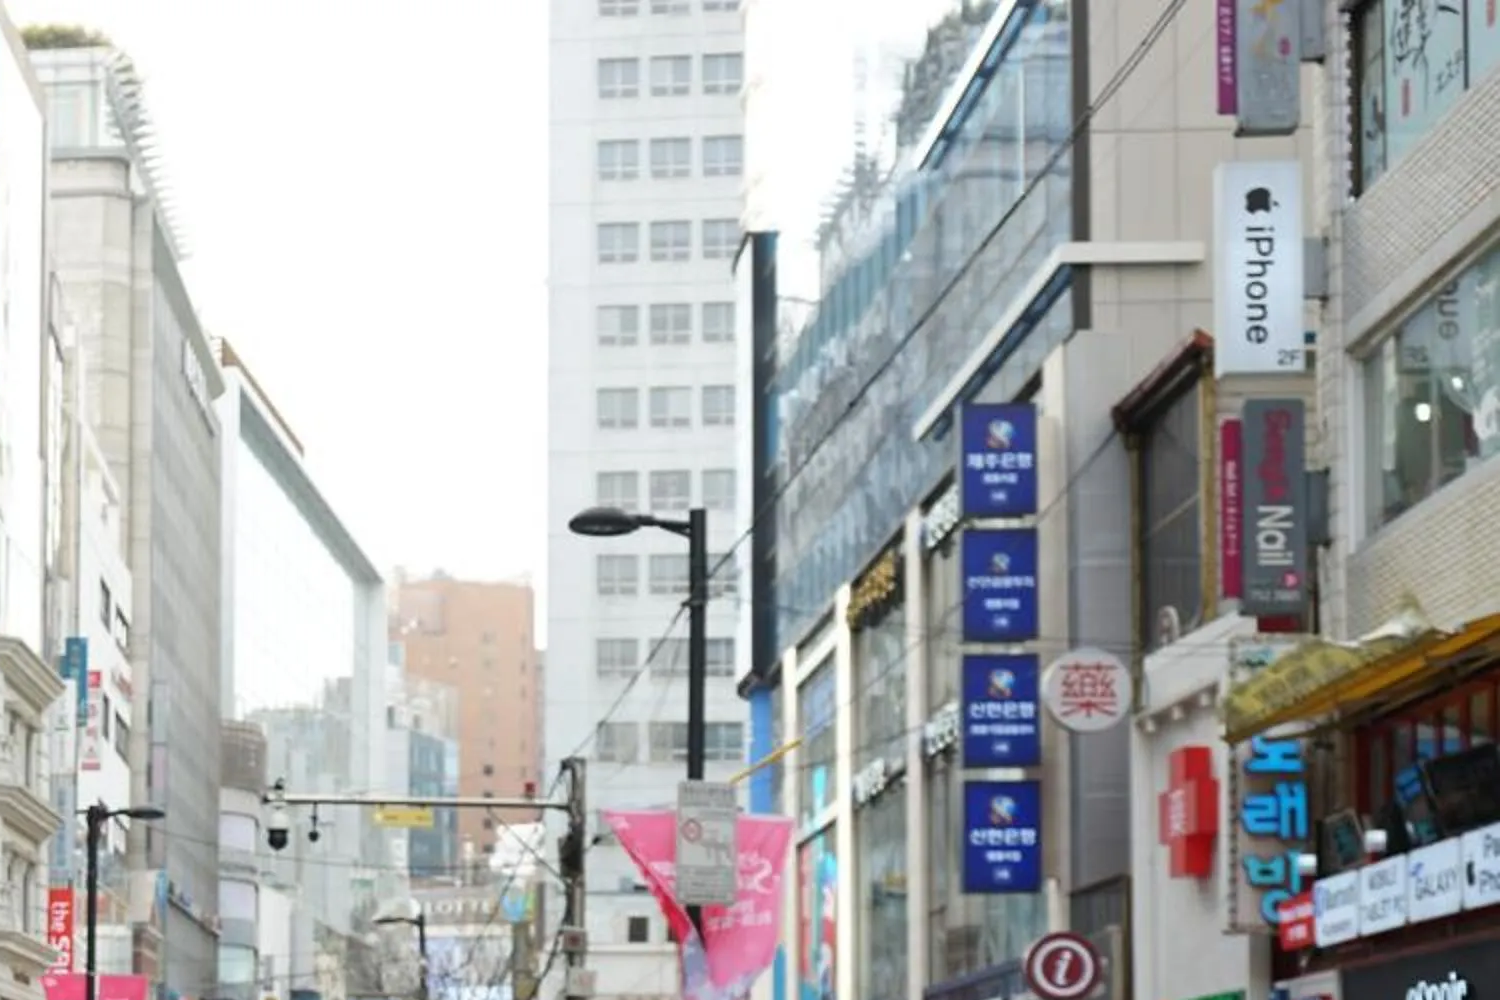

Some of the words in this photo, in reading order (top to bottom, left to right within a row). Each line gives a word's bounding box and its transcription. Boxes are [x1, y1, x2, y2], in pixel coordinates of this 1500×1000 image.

[1246, 226, 1275, 345] iPhone
[1257, 504, 1294, 567] Nail
[969, 702, 1035, 719] 신한은행
[969, 828, 1037, 846] 신한은행
